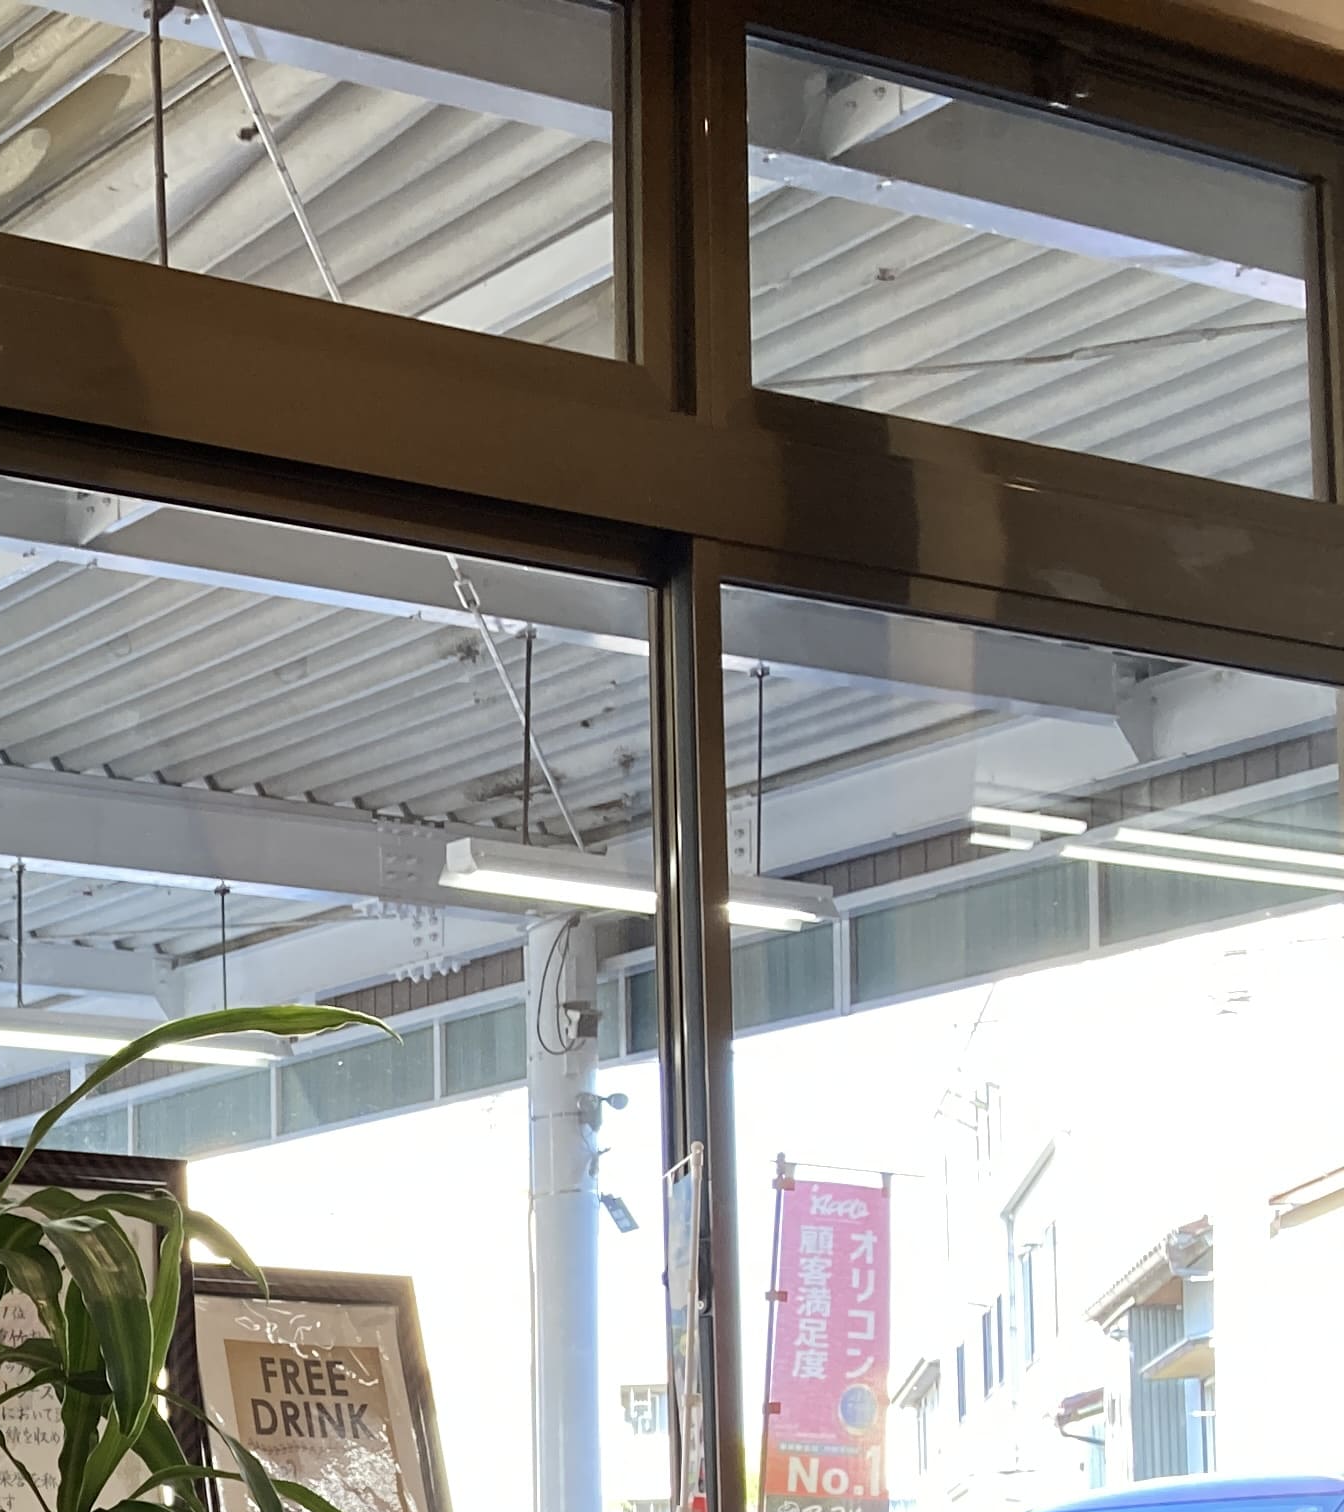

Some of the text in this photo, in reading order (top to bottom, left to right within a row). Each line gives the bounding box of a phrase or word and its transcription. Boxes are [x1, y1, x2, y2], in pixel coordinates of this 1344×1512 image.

[792, 1226, 834, 1380] 顧客満足度
[845, 1230, 878, 1380] オリコン
[259, 1356, 350, 1397] FREE
[251, 1398, 374, 1441] DRINK
[787, 1445, 881, 1497] No.1
